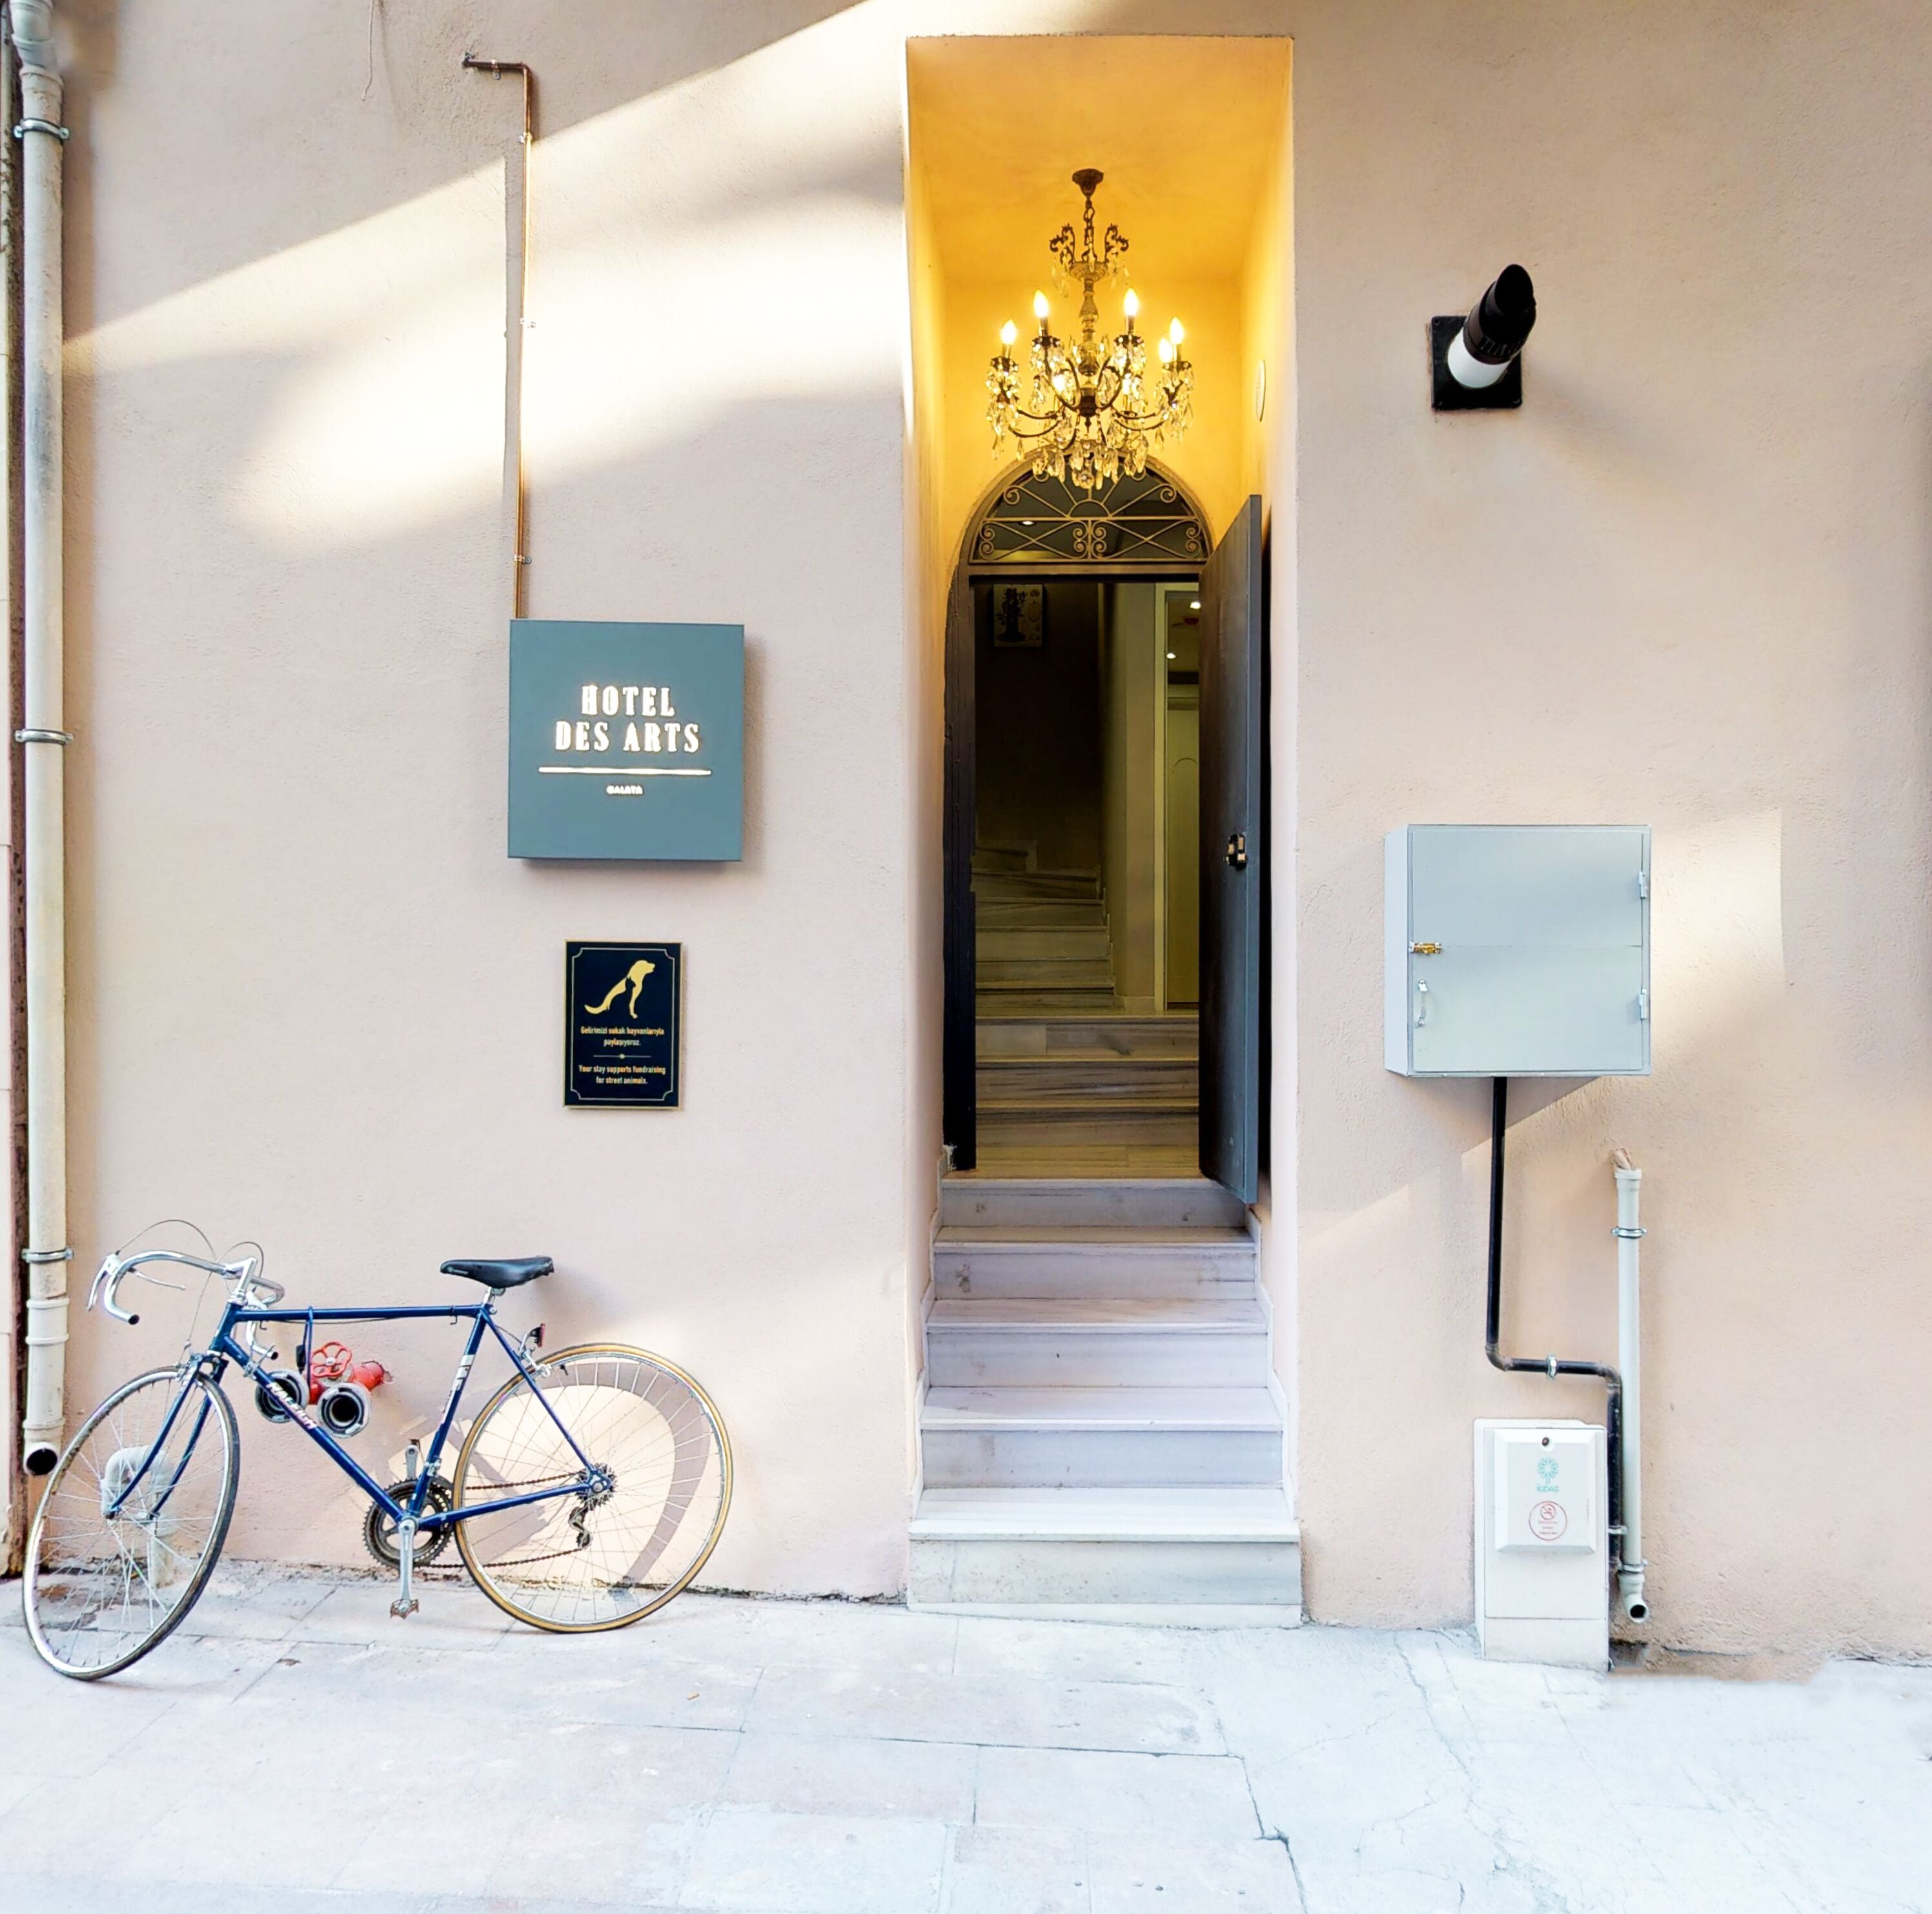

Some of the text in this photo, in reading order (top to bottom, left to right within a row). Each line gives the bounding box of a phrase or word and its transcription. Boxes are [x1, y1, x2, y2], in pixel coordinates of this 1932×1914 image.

[581, 685, 675, 717] HOTEL
[555, 720, 699, 753] DES ARTS
[606, 785, 643, 795] GALATA
[608, 1026, 625, 1035] sokak
[593, 1065, 605, 1074] stay
[607, 1065, 632, 1074] supports
[633, 1065, 666, 1075] fundraising
[605, 1076, 623, 1084] street
[624, 1076, 647, 1084] animals.
[265, 1381, 318, 1430] RALEIGH
